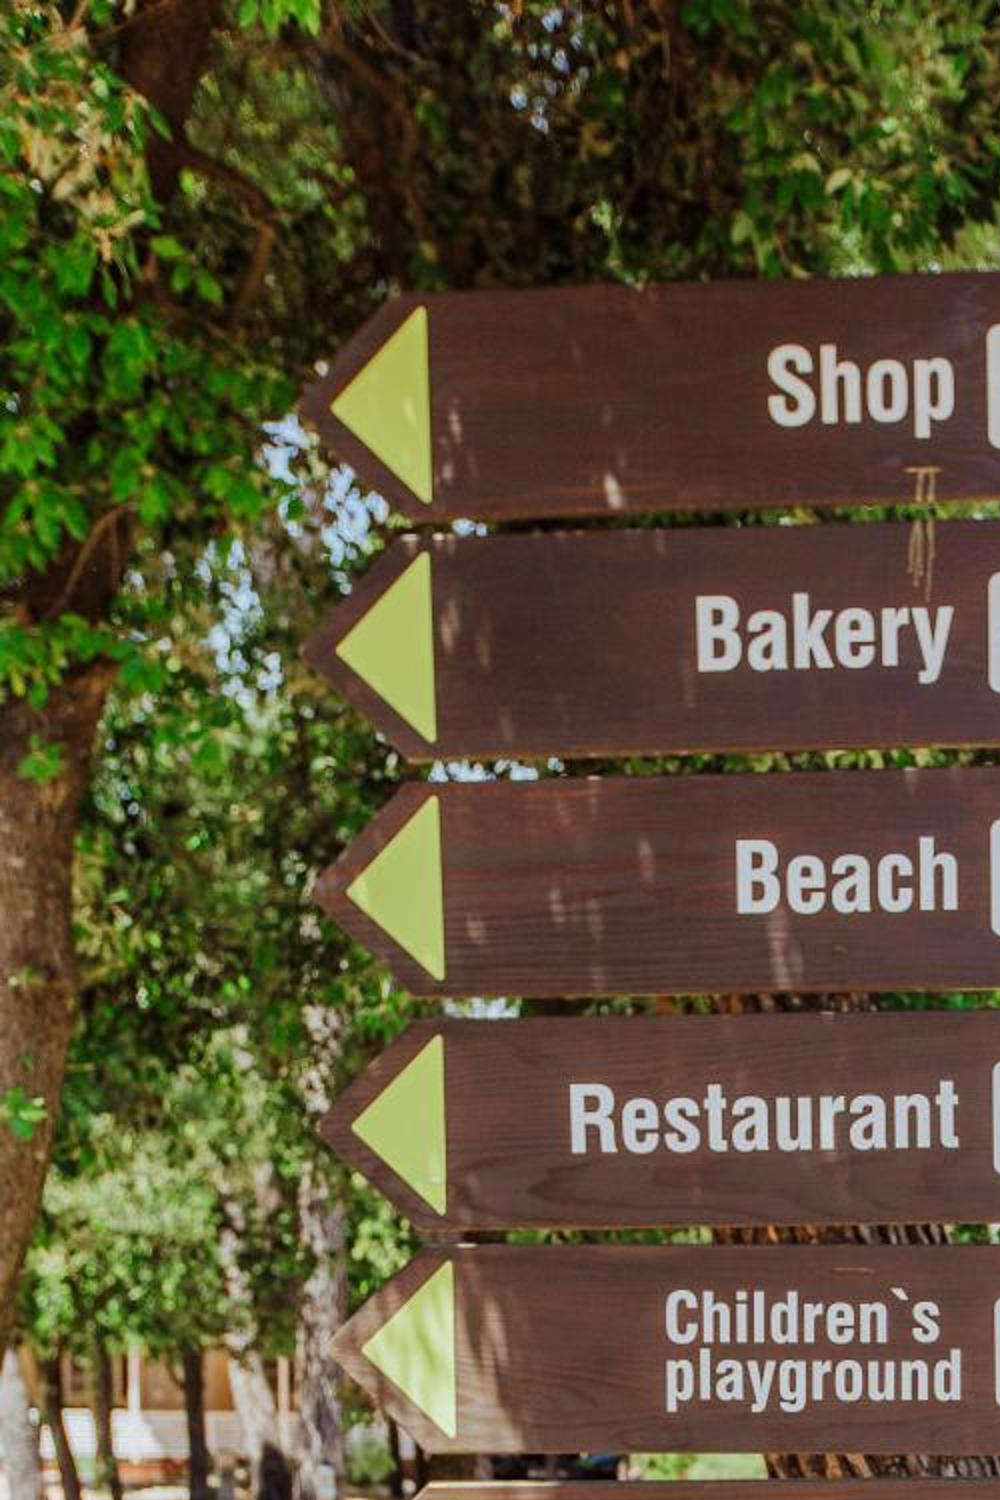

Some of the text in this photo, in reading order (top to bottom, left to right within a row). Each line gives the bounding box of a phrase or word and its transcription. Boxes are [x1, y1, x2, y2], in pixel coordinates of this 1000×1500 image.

[767, 344, 955, 440] Shop
[695, 592, 955, 685] Bakery
[734, 835, 959, 915] Beach
[568, 1079, 960, 1155] Restaurant
[665, 1347, 962, 1414] playground
